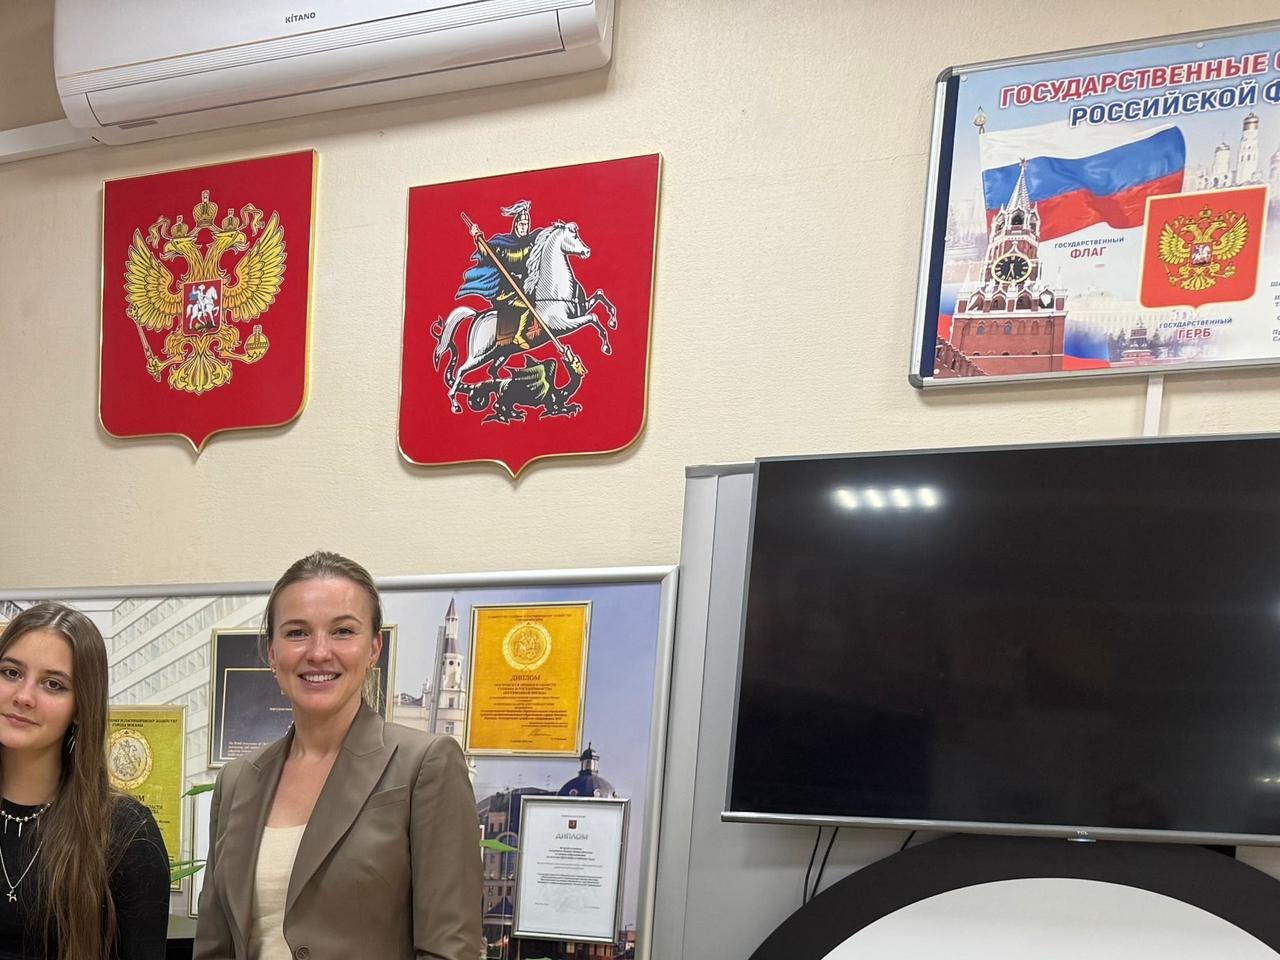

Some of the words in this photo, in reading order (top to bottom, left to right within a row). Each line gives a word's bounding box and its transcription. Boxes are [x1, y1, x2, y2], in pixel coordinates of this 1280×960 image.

[1001, 53, 1268, 107] ГОСУДАРСТВЕННЫЕ
[1070, 80, 1257, 127] РОССИЙСКОЙ
[1054, 237, 1124, 249] ГОСУДАРСТВЕННЫЙ
[1070, 246, 1106, 259] ФЛАГ
[1159, 317, 1233, 329] ГОСУДАРСТВЕННЫЙ
[1178, 328, 1211, 339] ГЕРБ
